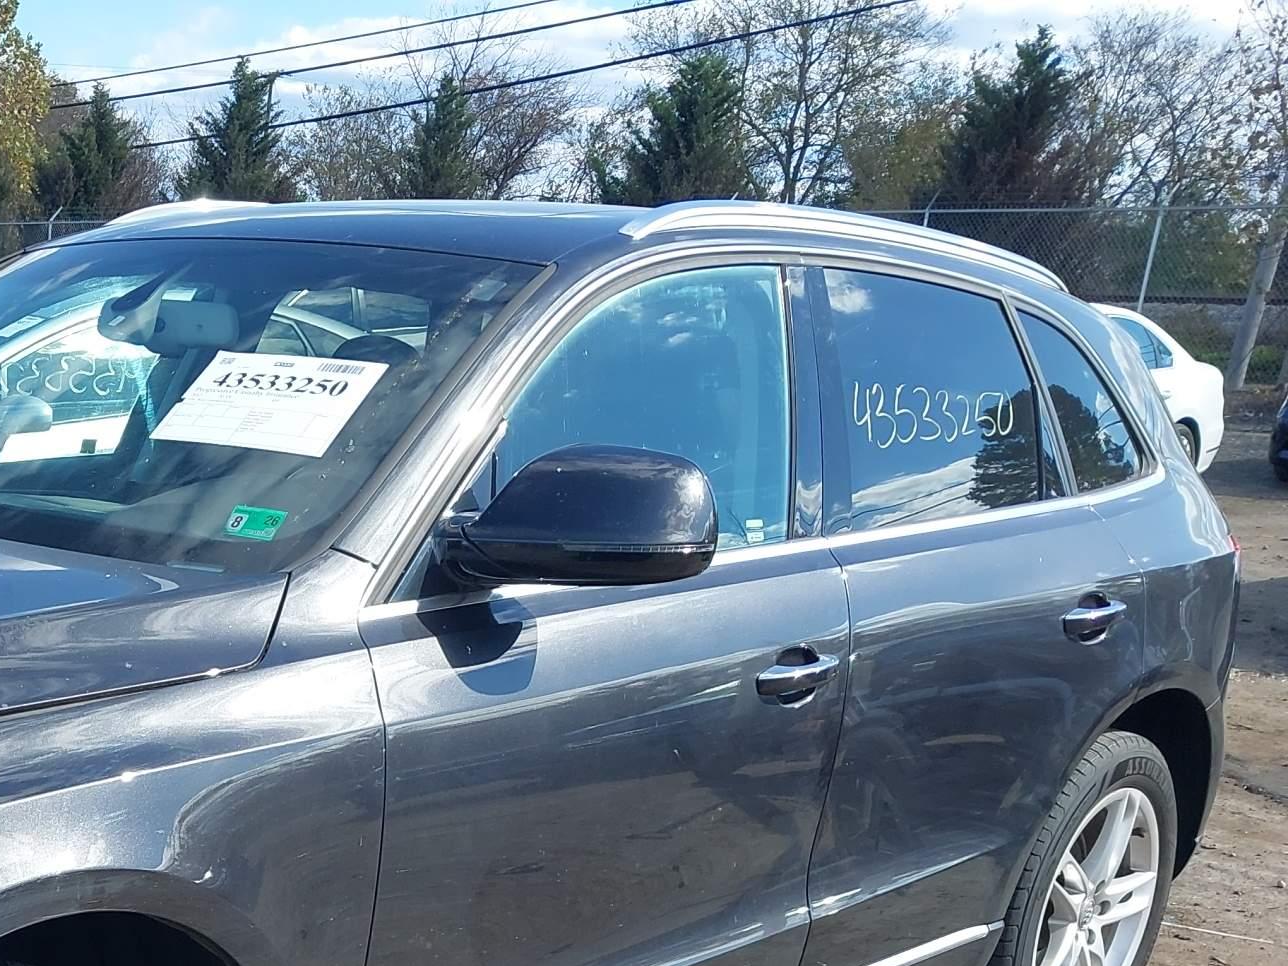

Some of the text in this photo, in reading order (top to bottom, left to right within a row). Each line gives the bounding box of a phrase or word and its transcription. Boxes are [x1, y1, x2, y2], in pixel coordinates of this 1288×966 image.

[212, 371, 349, 397] 43533250
[853, 381, 1014, 449] 43533250
[230, 515, 244, 528] 8
